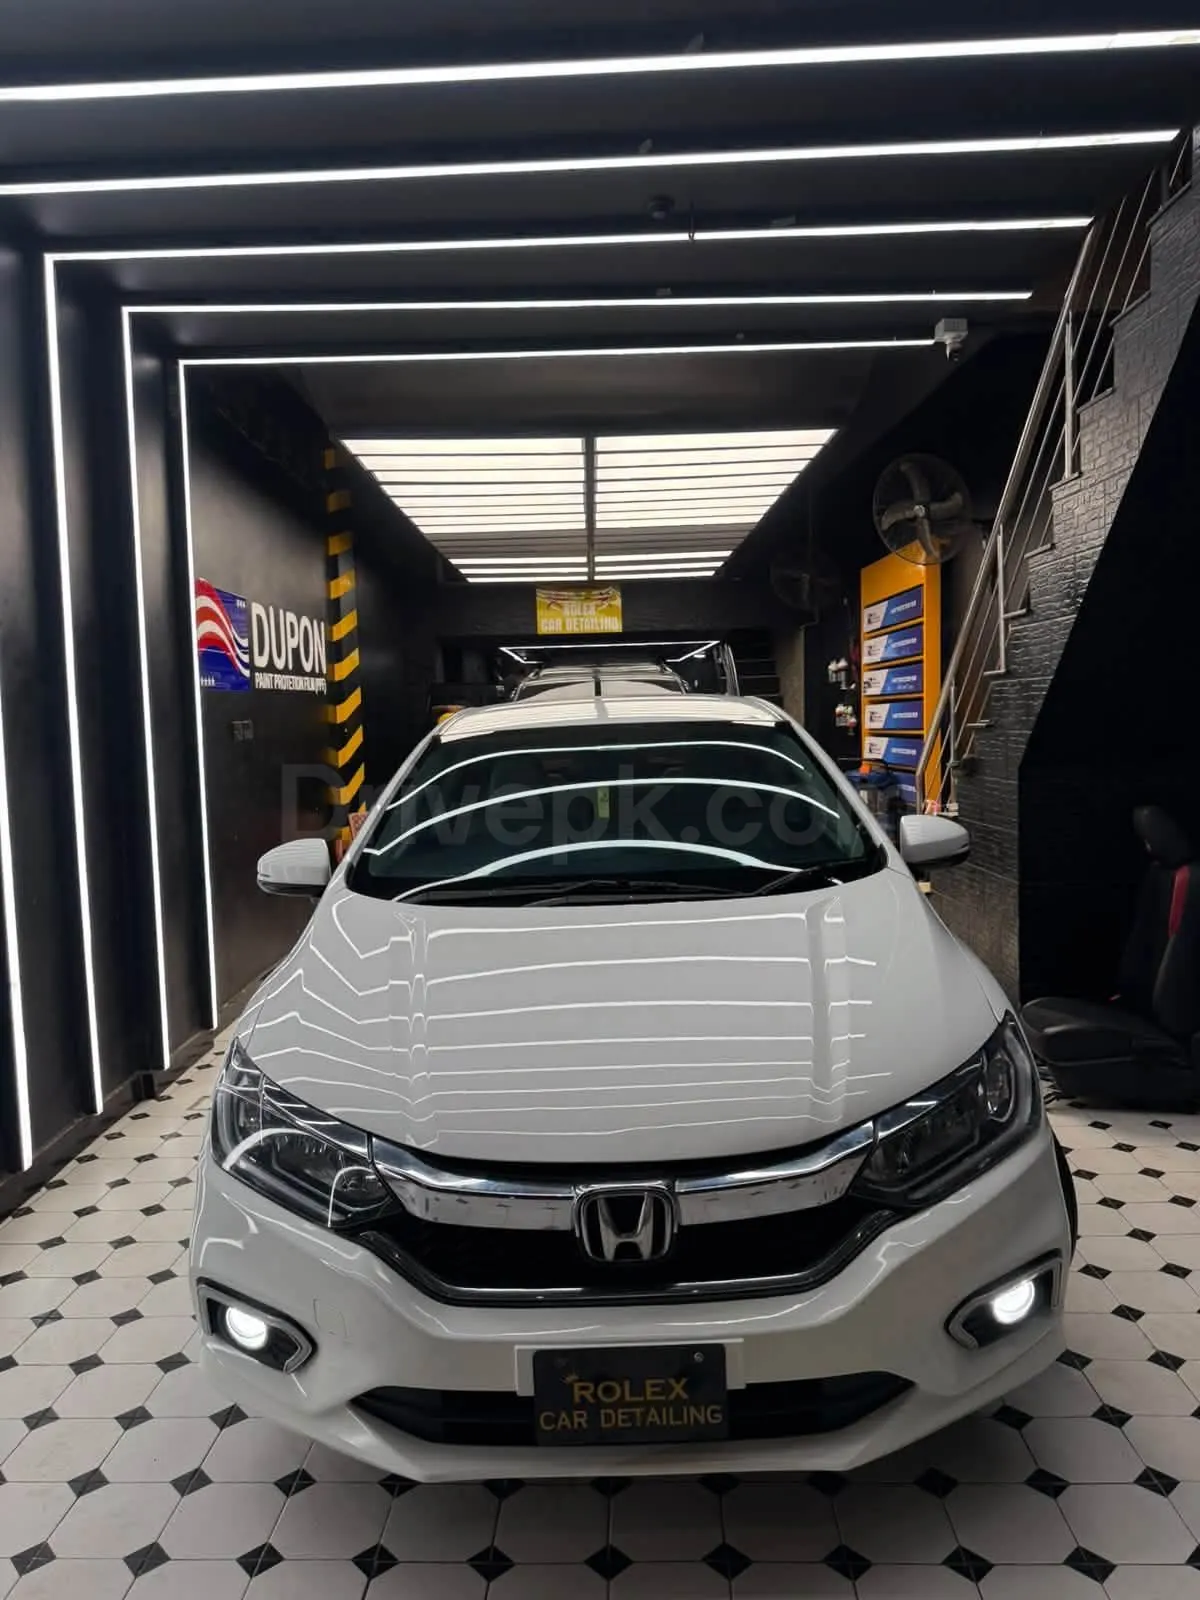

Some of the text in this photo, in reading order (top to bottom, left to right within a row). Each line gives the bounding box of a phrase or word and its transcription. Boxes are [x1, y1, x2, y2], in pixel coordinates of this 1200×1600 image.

[573, 1378, 690, 1403] ROLEX
[540, 1405, 723, 1431] CAR DETAILING
